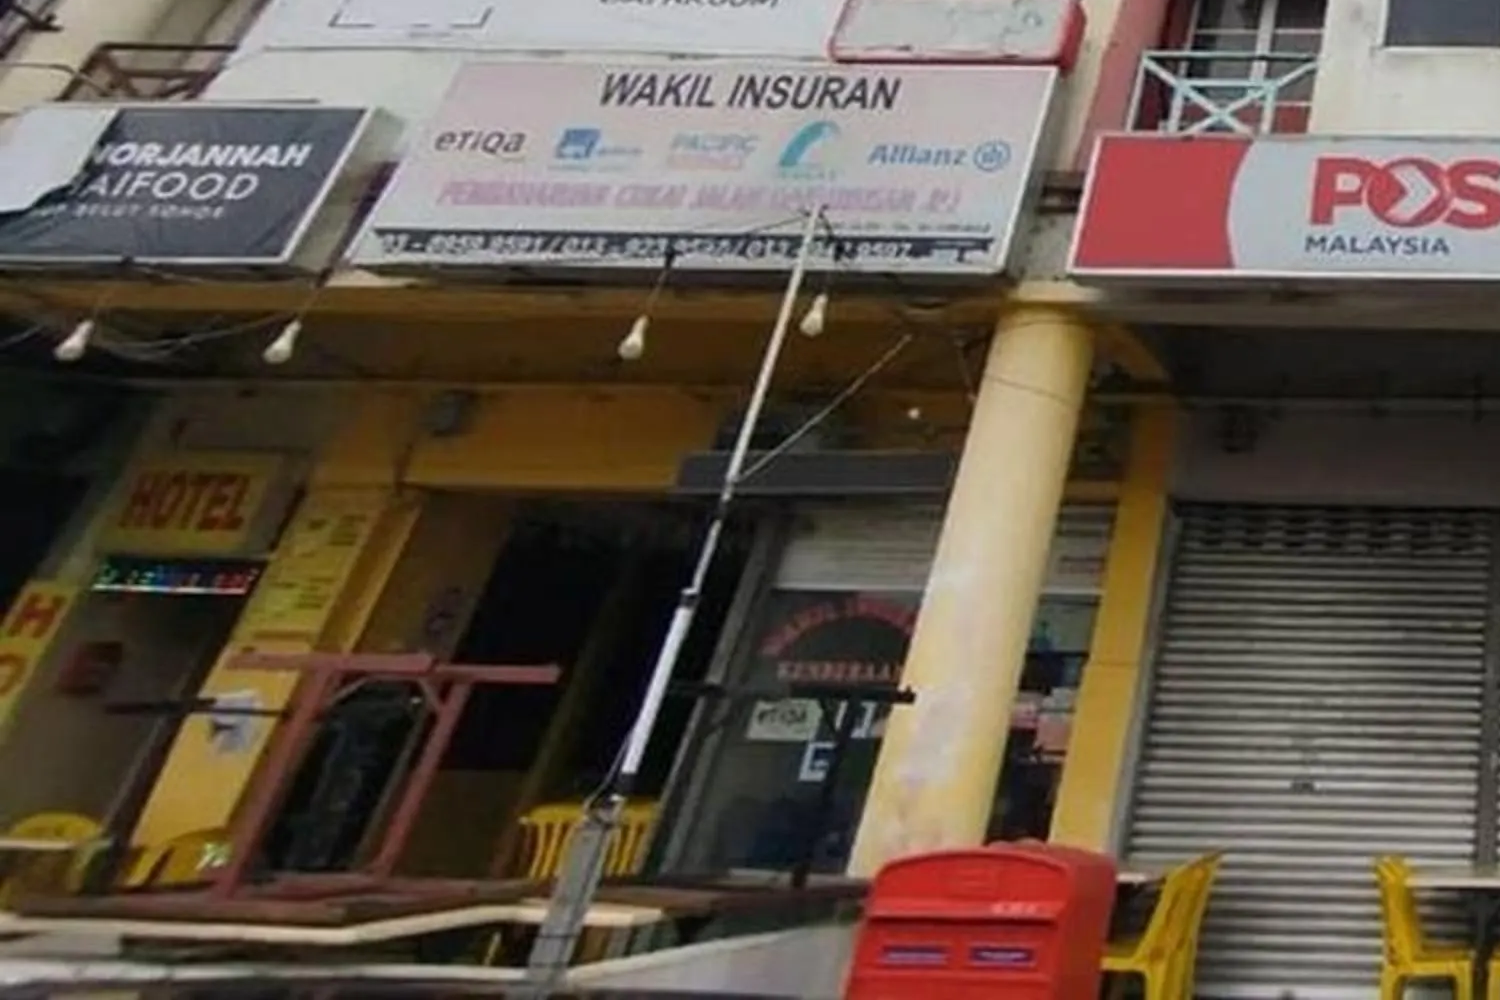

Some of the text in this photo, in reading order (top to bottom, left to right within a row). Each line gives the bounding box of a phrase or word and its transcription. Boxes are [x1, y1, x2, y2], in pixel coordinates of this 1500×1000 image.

[600, 74, 902, 110] WAKIL INSURAN
[867, 141, 966, 168] Allianz
[1304, 235, 1451, 256] MALAYSIA
[118, 470, 251, 530] HOTEL
